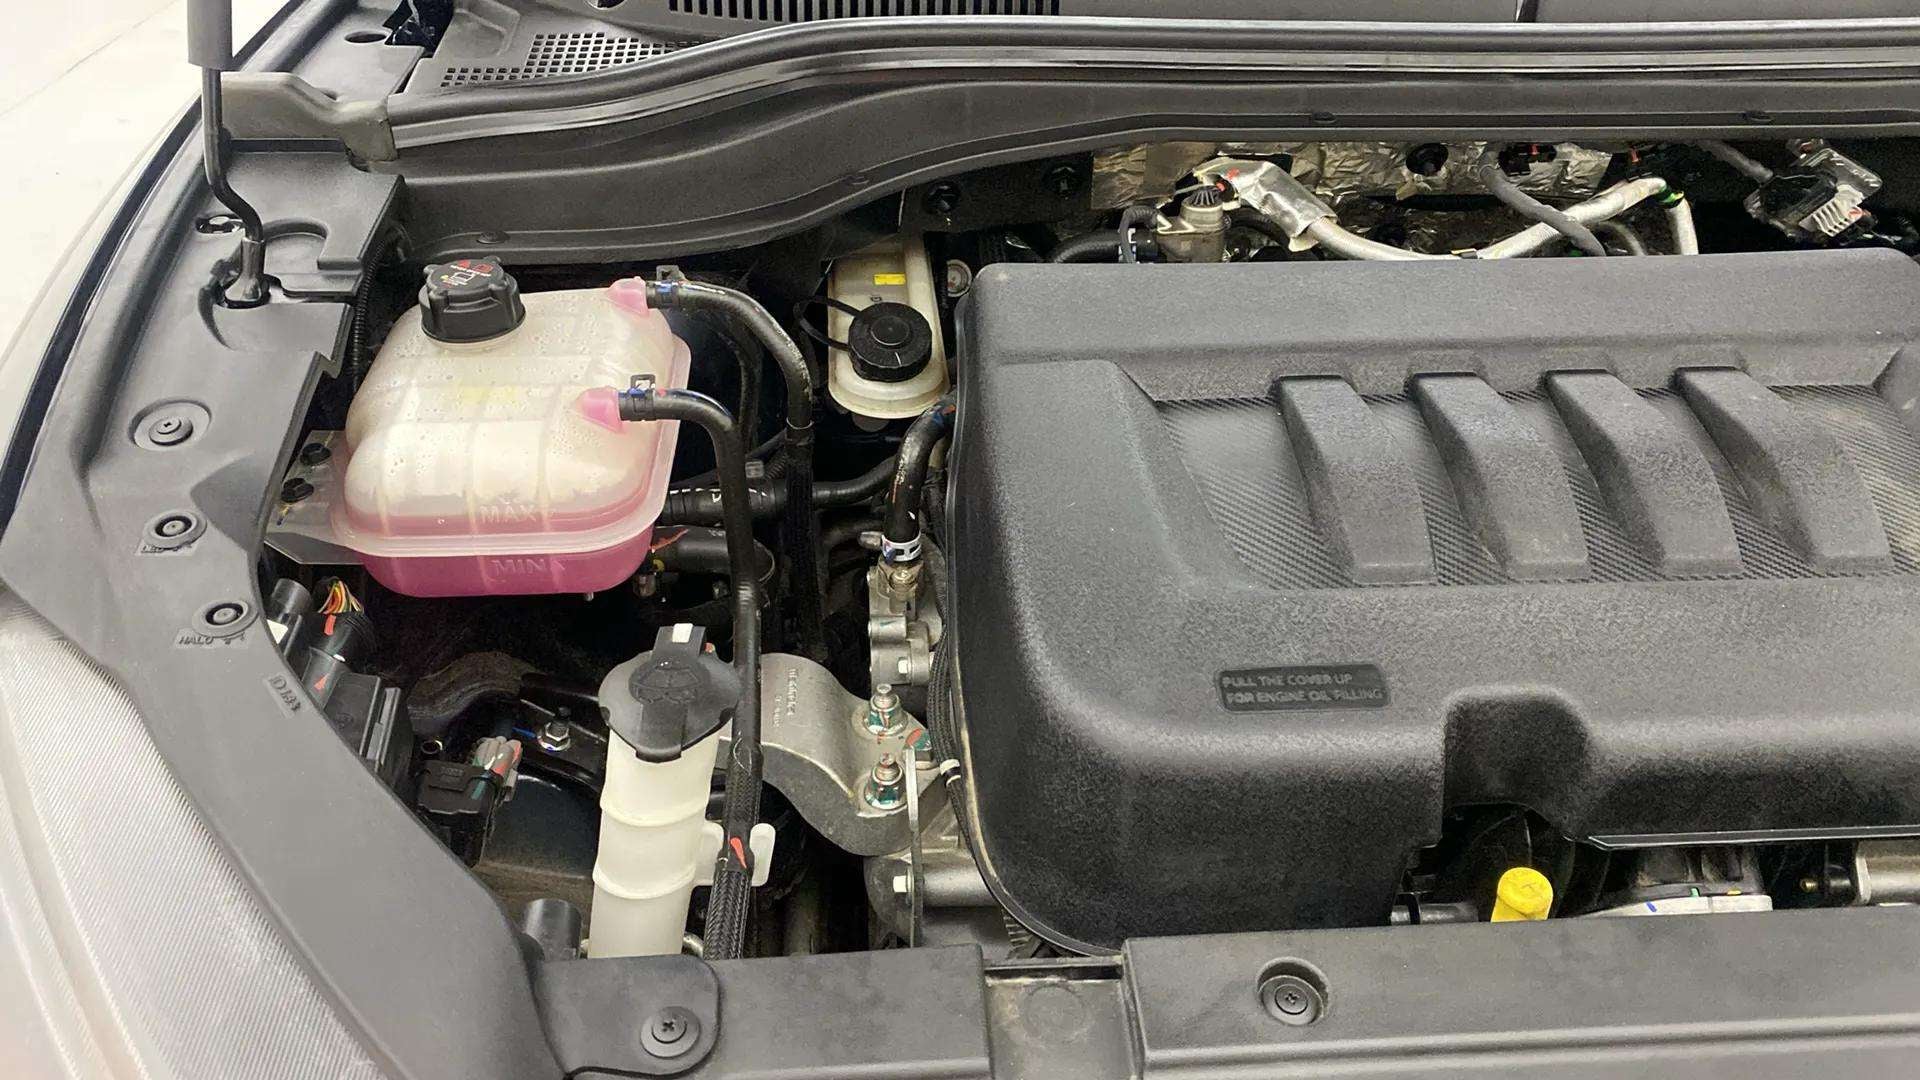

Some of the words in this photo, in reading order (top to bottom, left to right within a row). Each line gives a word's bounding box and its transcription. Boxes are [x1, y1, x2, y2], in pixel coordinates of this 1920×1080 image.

[480, 504, 537, 523] MAX
[489, 558, 546, 576] MIN
[178, 635, 214, 646] HALO
[1221, 676, 1257, 688] PULL
[1258, 674, 1285, 687] THE
[1287, 673, 1332, 686] COVER
[1333, 673, 1353, 685] UP
[1225, 691, 1256, 704] FOR
[1256, 690, 1305, 703] ENGINE
[1308, 689, 1328, 702] OIL
[1330, 688, 1383, 701] FILLING
